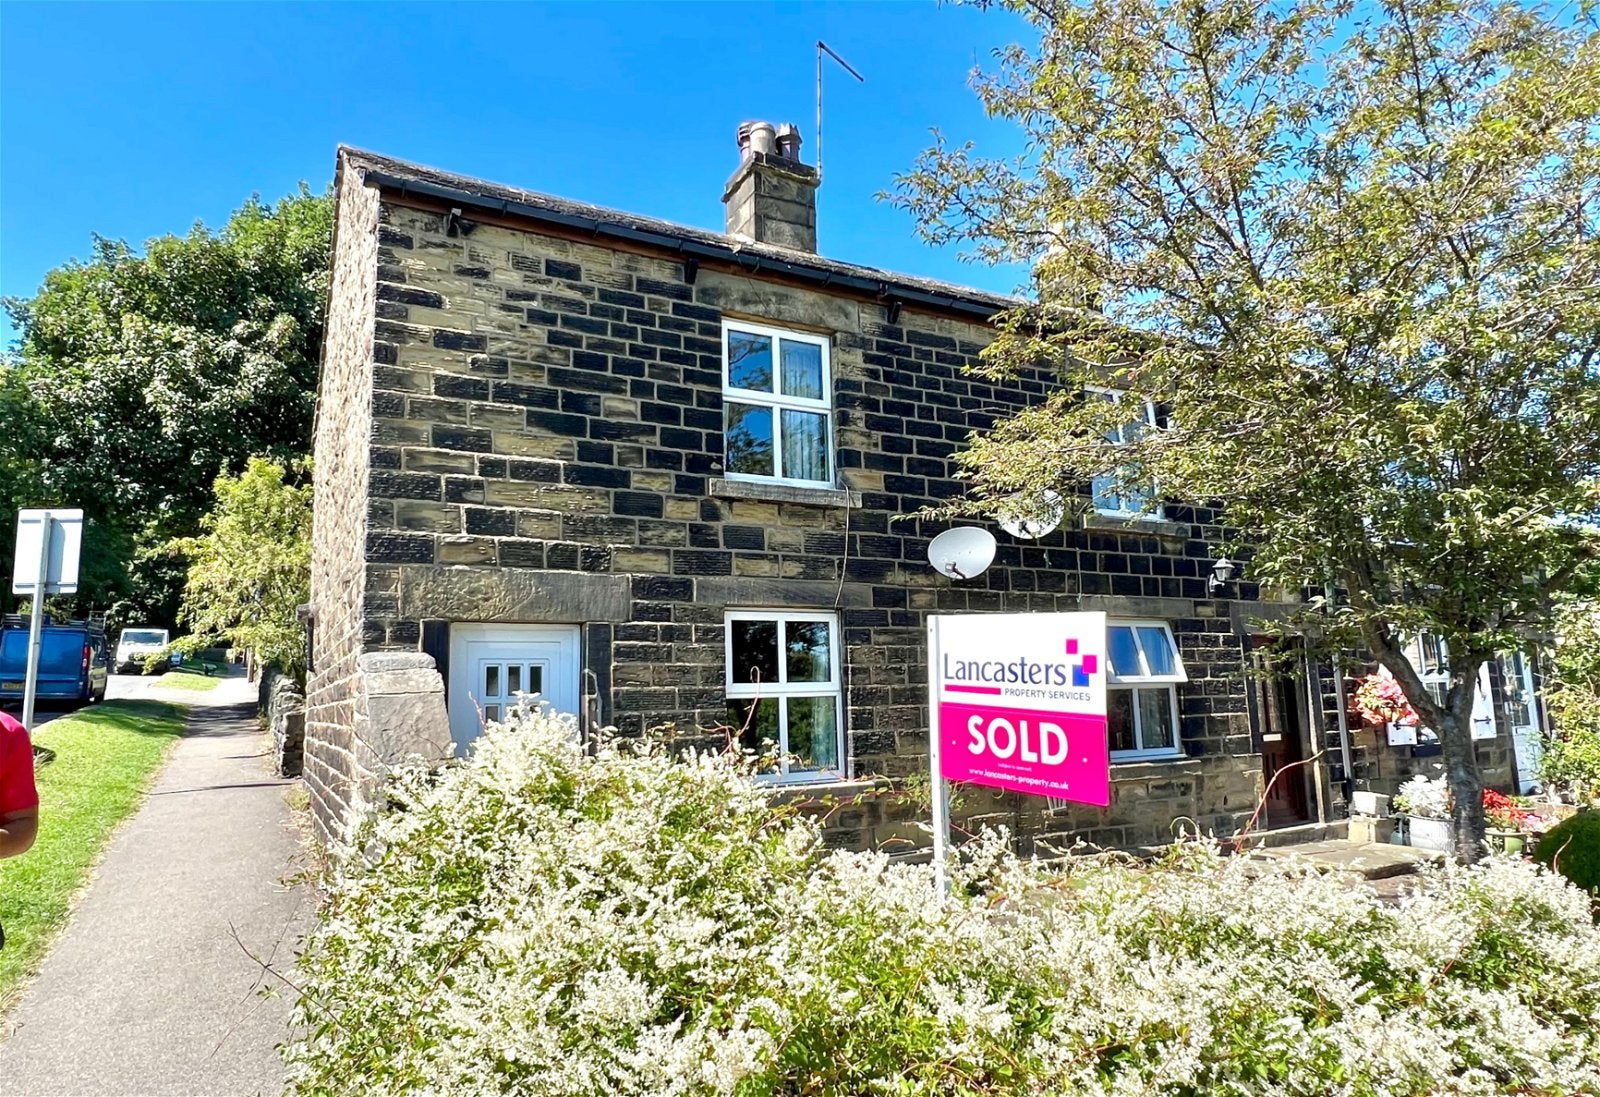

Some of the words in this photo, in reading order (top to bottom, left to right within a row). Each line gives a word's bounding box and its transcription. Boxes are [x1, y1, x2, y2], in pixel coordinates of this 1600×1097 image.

[944, 653, 1067, 686] Lancasters
[1004, 688, 1046, 699] PROPERTY
[1048, 690, 1091, 701] SERVICES
[967, 714, 1069, 766] SOLD
[968, 768, 1069, 790] www.lancasters-property.co.uk
